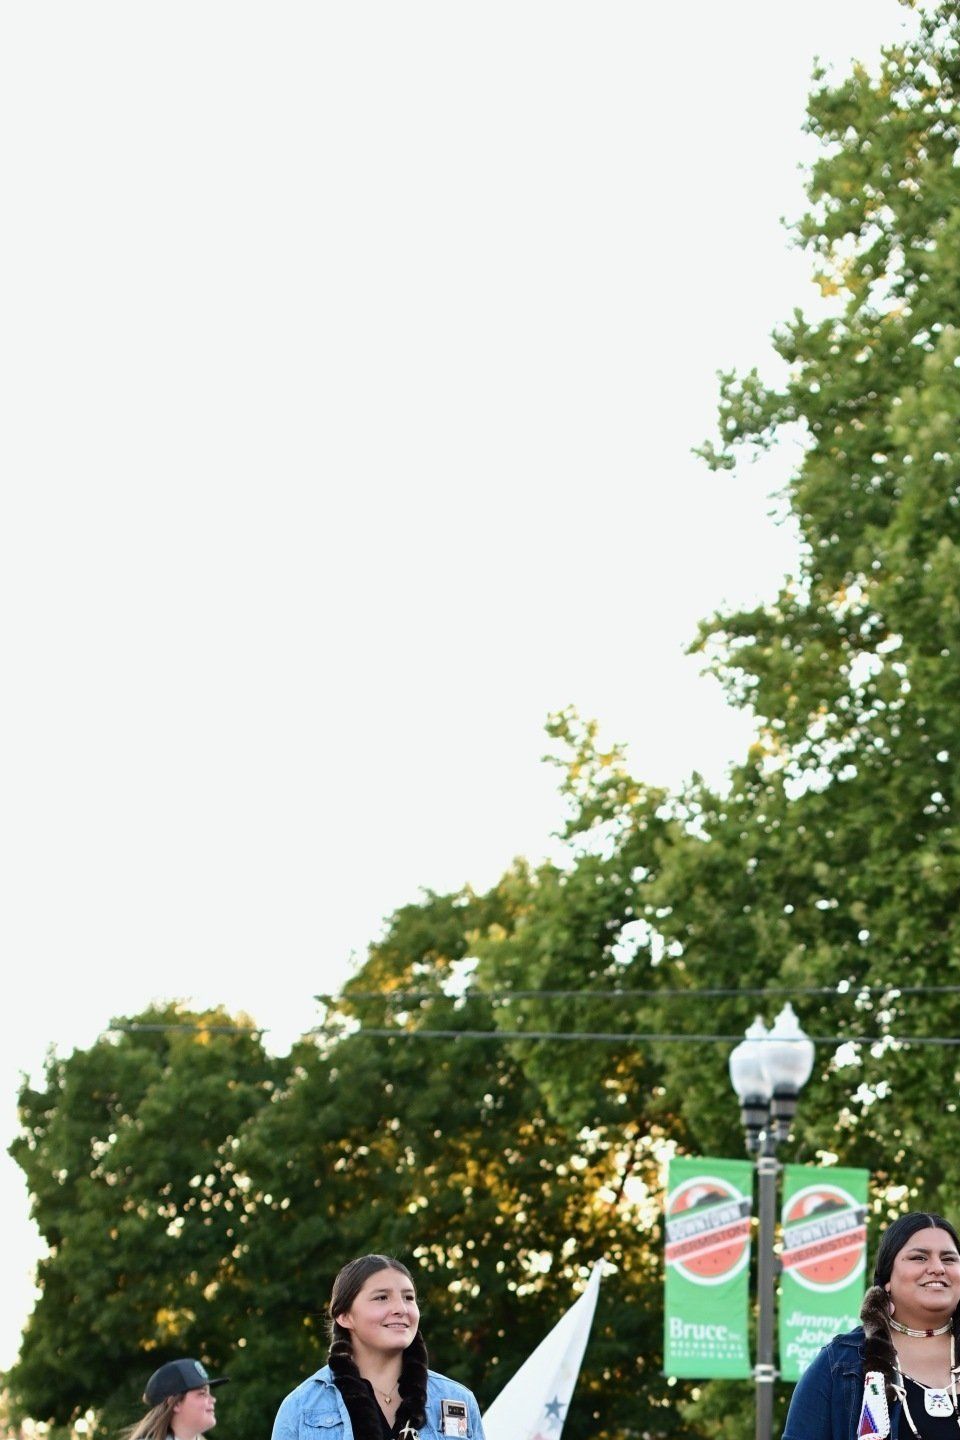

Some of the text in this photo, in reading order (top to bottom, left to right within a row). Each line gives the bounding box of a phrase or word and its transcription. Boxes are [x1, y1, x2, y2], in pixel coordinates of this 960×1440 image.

[674, 1223, 747, 1254] HERMISTON
[790, 1232, 863, 1262] HERMISTON
[669, 1317, 728, 1340] Bruce
[786, 1311, 858, 1331] Jimmy's
